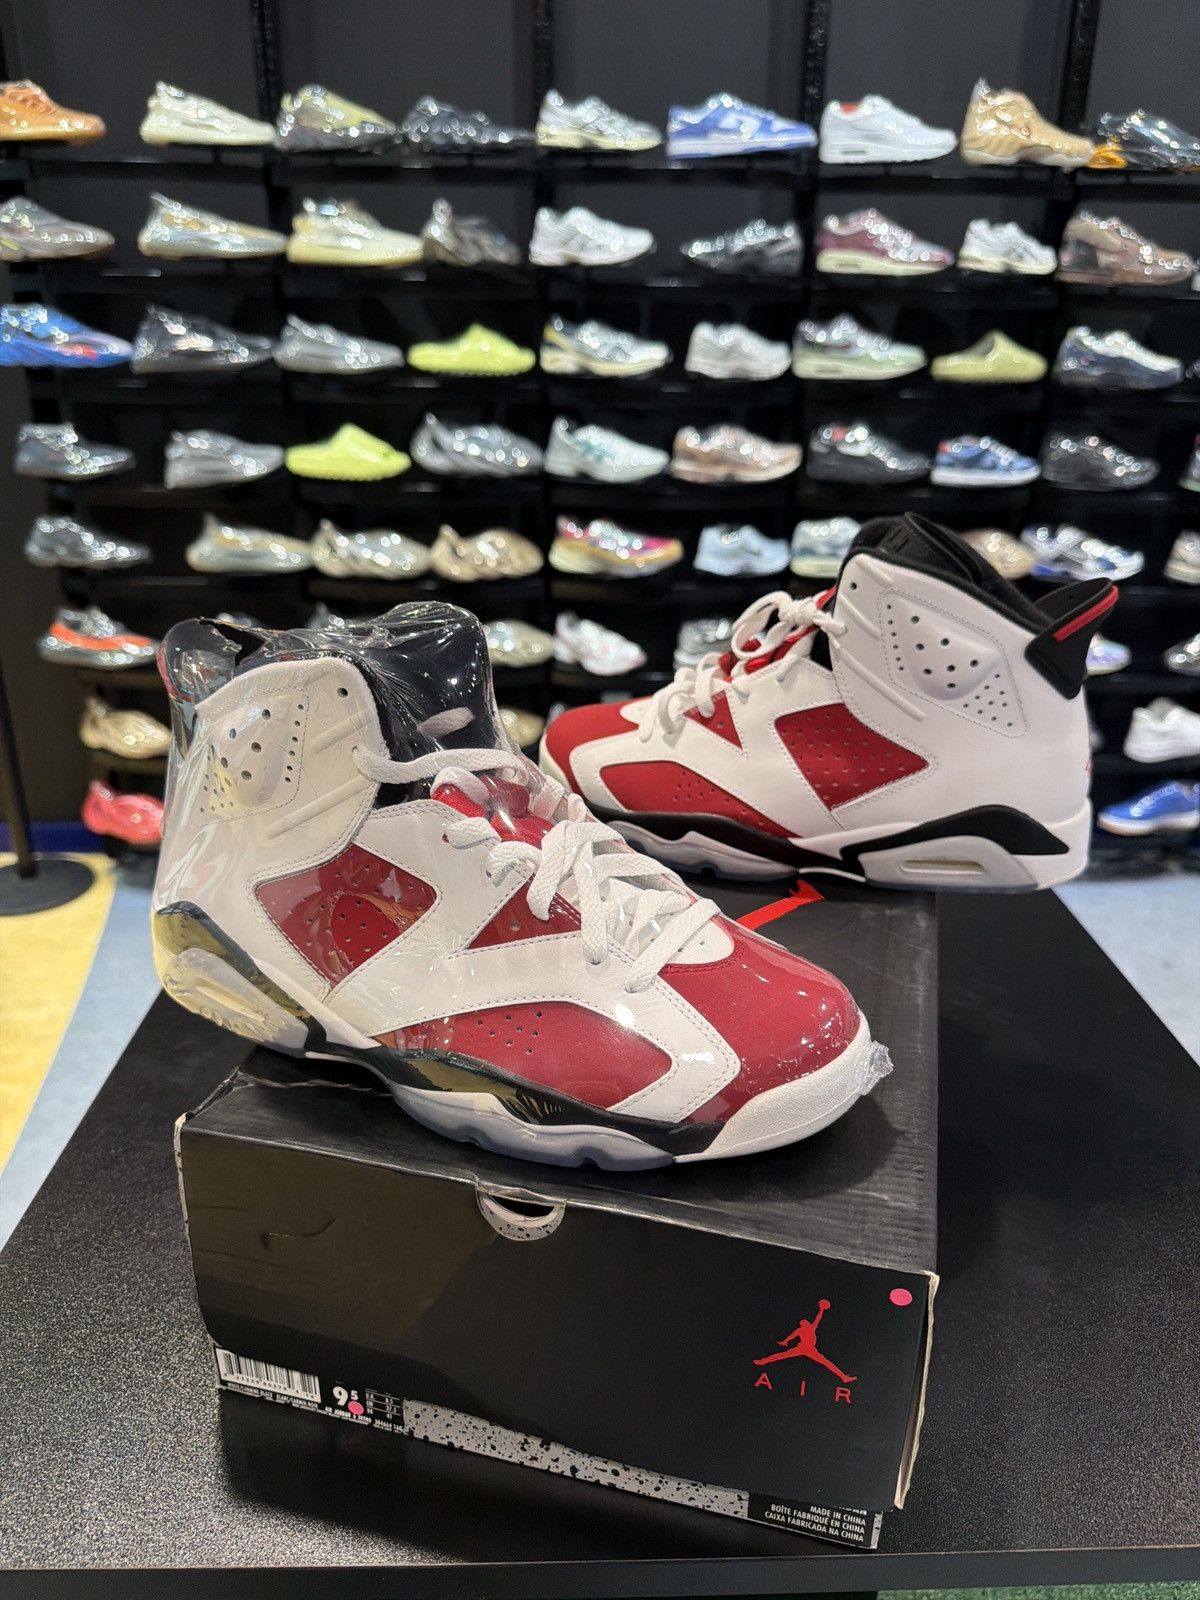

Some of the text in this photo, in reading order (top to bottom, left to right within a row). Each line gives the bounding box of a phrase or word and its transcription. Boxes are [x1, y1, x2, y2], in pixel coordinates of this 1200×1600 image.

[764, 1510, 865, 1543] CAIXA FABRICADA NA CHINA
[809, 1505, 831, 1518] MADE
[832, 1510, 842, 1520] IN
[843, 1513, 866, 1527] CHINA
[830, 1518, 841, 1529] EN
[842, 1521, 866, 1535] CHINA
